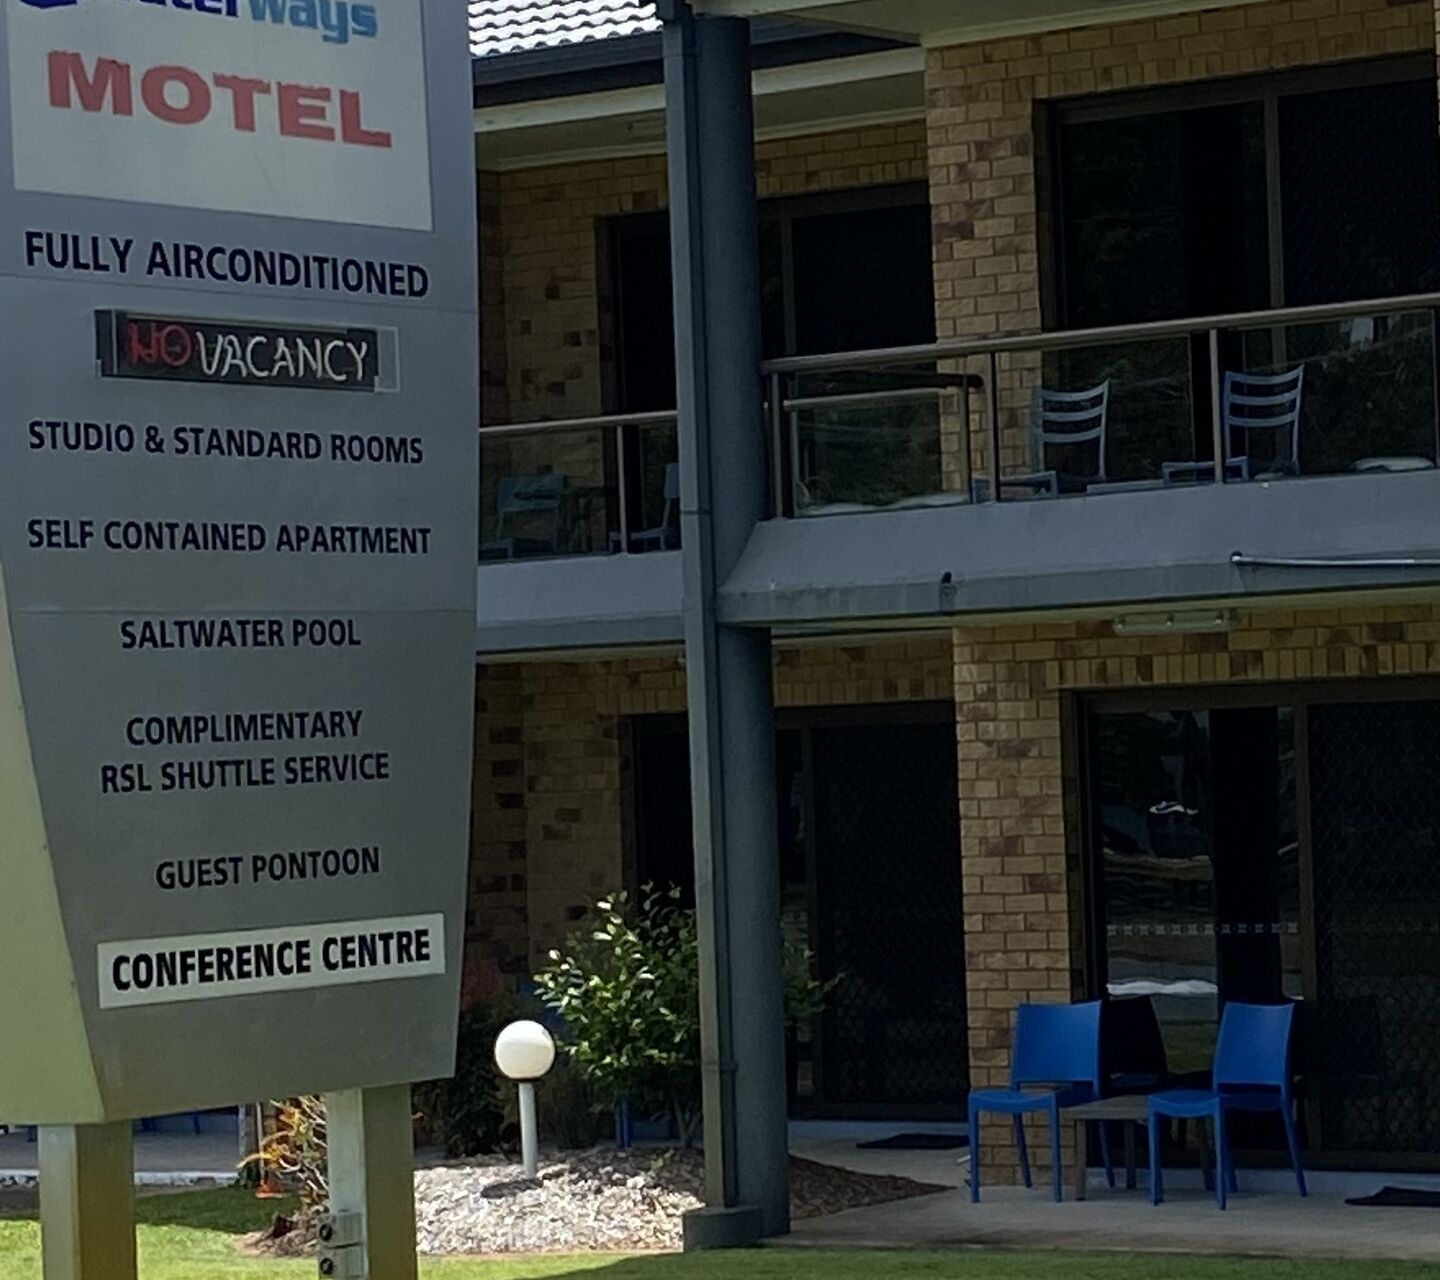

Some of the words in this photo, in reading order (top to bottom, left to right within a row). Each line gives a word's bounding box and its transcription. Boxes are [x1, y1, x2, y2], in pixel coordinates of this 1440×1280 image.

[47, 49, 392, 148] MOTEL
[25, 231, 133, 273] FULLY
[147, 241, 429, 298] AIRCONDITIONED
[196, 332, 368, 381] VACANCY
[29, 421, 134, 452] STUDIO
[145, 427, 165, 453] &
[174, 426, 322, 460] STANDARD
[331, 434, 424, 463] ROOMS
[28, 519, 94, 549] SELF
[104, 521, 266, 553] CONTAINED
[276, 525, 431, 554] APARTMENT
[121, 619, 284, 649] SALTWATER
[292, 619, 361, 647] POOL
[126, 710, 363, 746] COMPLIMENTARY
[102, 764, 152, 794] RSL
[161, 758, 275, 791] SHUTTLE
[284, 752, 390, 785] SERVICE
[155, 856, 243, 890] GUEST
[252, 846, 380, 883] PONTOON
[112, 939, 312, 991] CONFERENCE
[322, 928, 431, 971] CENTRE
